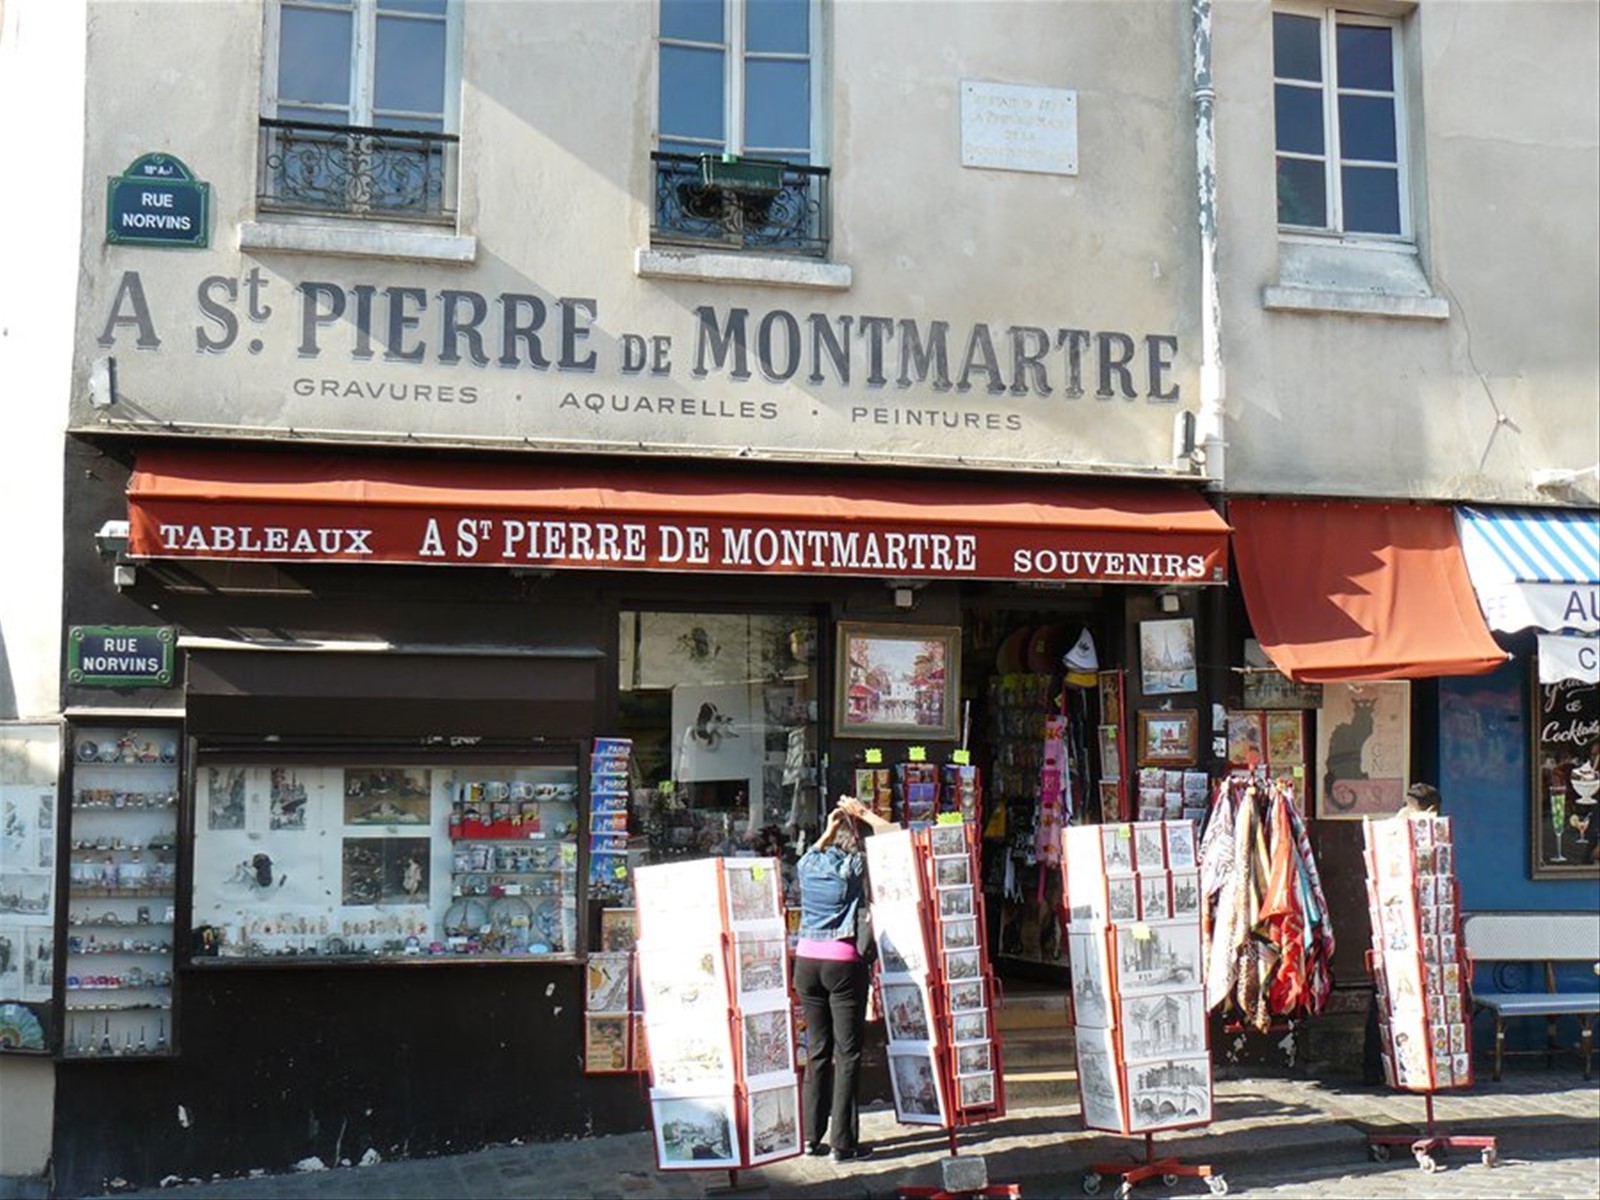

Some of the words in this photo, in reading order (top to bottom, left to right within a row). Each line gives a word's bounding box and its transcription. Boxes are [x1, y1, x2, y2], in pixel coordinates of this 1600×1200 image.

[141, 192, 173, 208] RUE
[122, 213, 191, 230] NORVINS
[96, 270, 162, 351] A
[298, 280, 598, 371] PIERRE
[621, 333, 672, 375] DE
[692, 304, 1181, 401] MONTMARTRE
[293, 379, 478, 404] GRAVURES
[559, 393, 778, 419] AQUARELLES
[851, 407, 1022, 431] PEINTURES
[160, 524, 373, 556] TABLEAUX
[419, 518, 446, 556] A
[501, 519, 647, 562] PIERRE
[658, 524, 710, 565] DE
[721, 528, 977, 571] MONTMARTRE
[1013, 549, 1206, 579] SOUVENIRS
[103, 637, 138, 653] RUE
[83, 656, 159, 672] NORVINS
